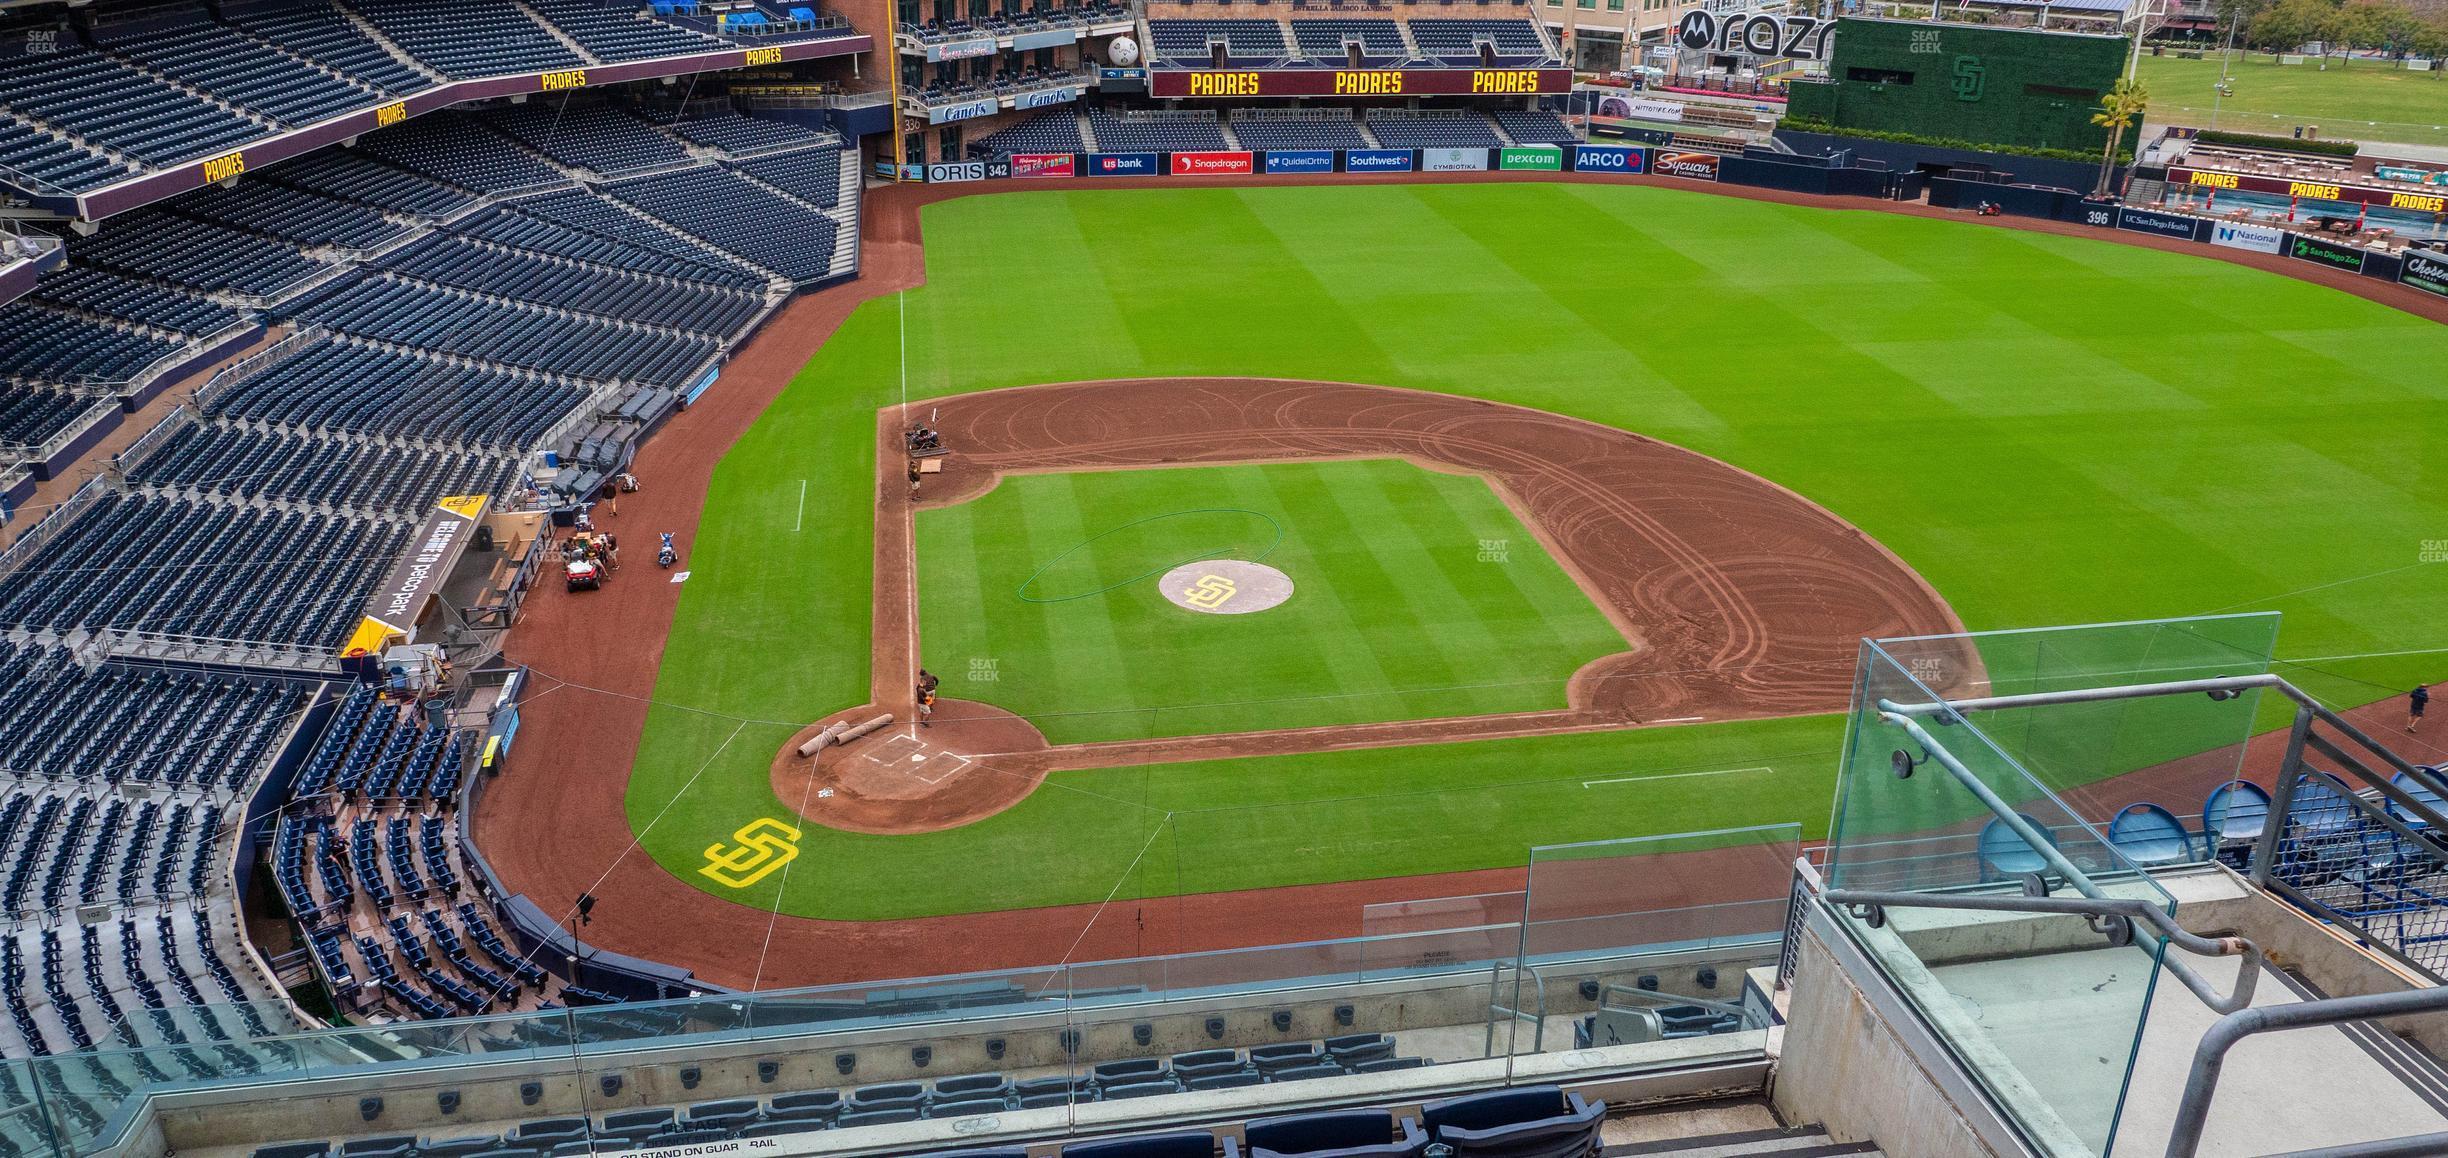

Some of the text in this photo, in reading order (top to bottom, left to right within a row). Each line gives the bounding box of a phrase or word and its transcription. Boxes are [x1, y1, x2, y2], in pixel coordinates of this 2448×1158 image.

[1720, 13, 1838, 60] razr
[745, 47, 783, 65] PADRES
[541, 70, 586, 91] PADRES
[1190, 72, 1259, 96] PADRES
[1335, 71, 1402, 95] PADRES
[1472, 71, 1538, 94] PADRES
[1028, 89, 1066, 107] Canel's
[377, 102, 407, 127] PADRES
[944, 103, 986, 121] Canel's
[905, 119, 920, 131] 336
[204, 153, 245, 183] PADRES
[1103, 158, 1143, 169] us bank
[1194, 158, 1248, 169] Snapdragon
[1281, 157, 1330, 167] QuidelOrtho
[1350, 155, 1401, 166] Southwest
[1578, 152, 1625, 167] ARCO
[1656, 152, 1712, 175] Sycuan
[931, 164, 982, 181] ORIS
[988, 164, 1008, 177] 342
[2191, 171, 2239, 189] PADRES
[2289, 182, 2341, 200] PADRES
[2391, 193, 2446, 213] PADRES
[2087, 211, 2109, 225] 396
[2125, 215, 2190, 233] UC San Diego Health
[2237, 230, 2278, 244] National
[2309, 247, 2361, 266] San Diego Zoo
[401, 563, 432, 592] petco
[384, 592, 414, 616] park
[86, 910, 101, 919] 102
[641, 1149, 681, 1158] STAND
[685, 1146, 702, 1156] ON
[706, 1143, 739, 1154] GUAR
